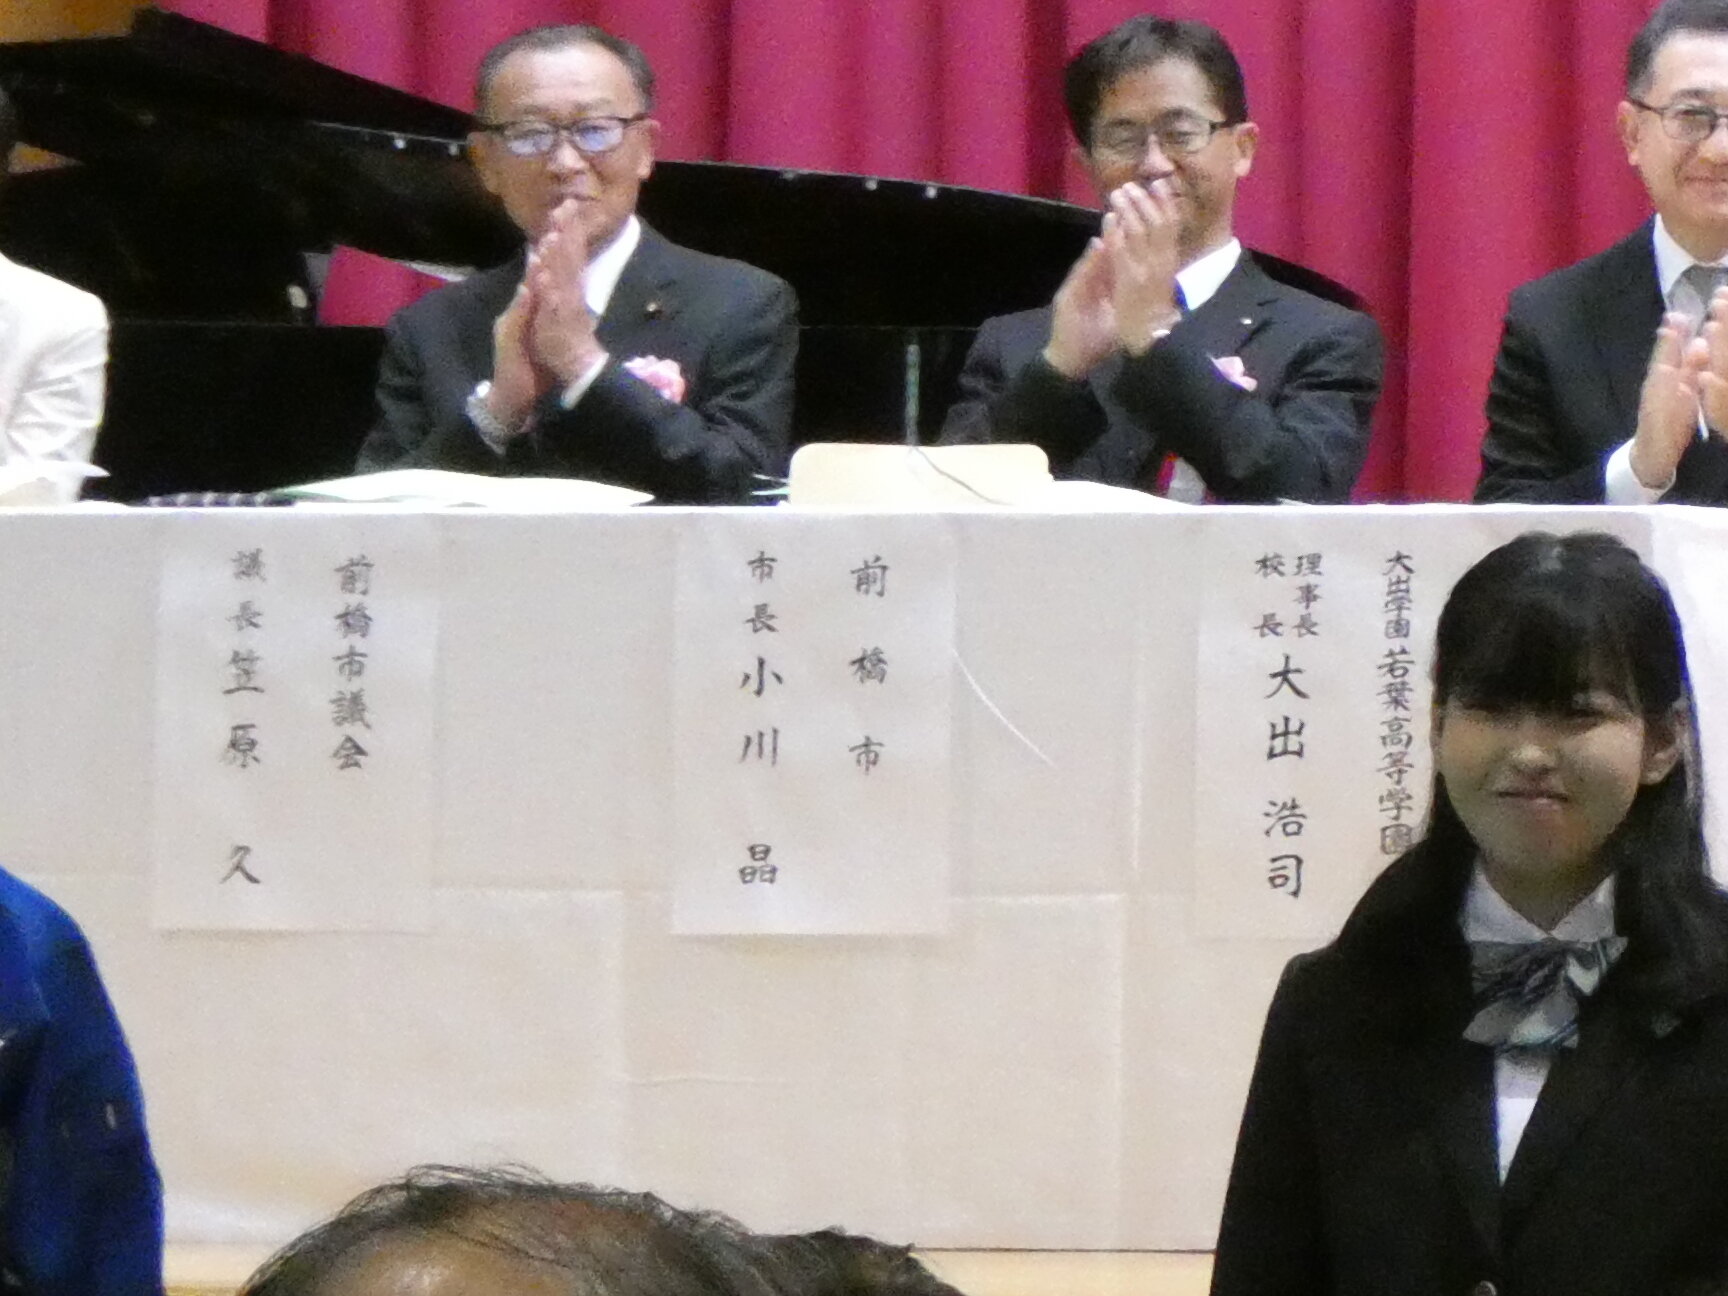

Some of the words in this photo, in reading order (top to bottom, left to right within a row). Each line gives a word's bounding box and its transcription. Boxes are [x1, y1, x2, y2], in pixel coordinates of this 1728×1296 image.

[329, 554, 374, 771] 前橋市議会
[848, 554, 890, 776] 前橋市
[1291, 552, 1324, 638] 理事長
